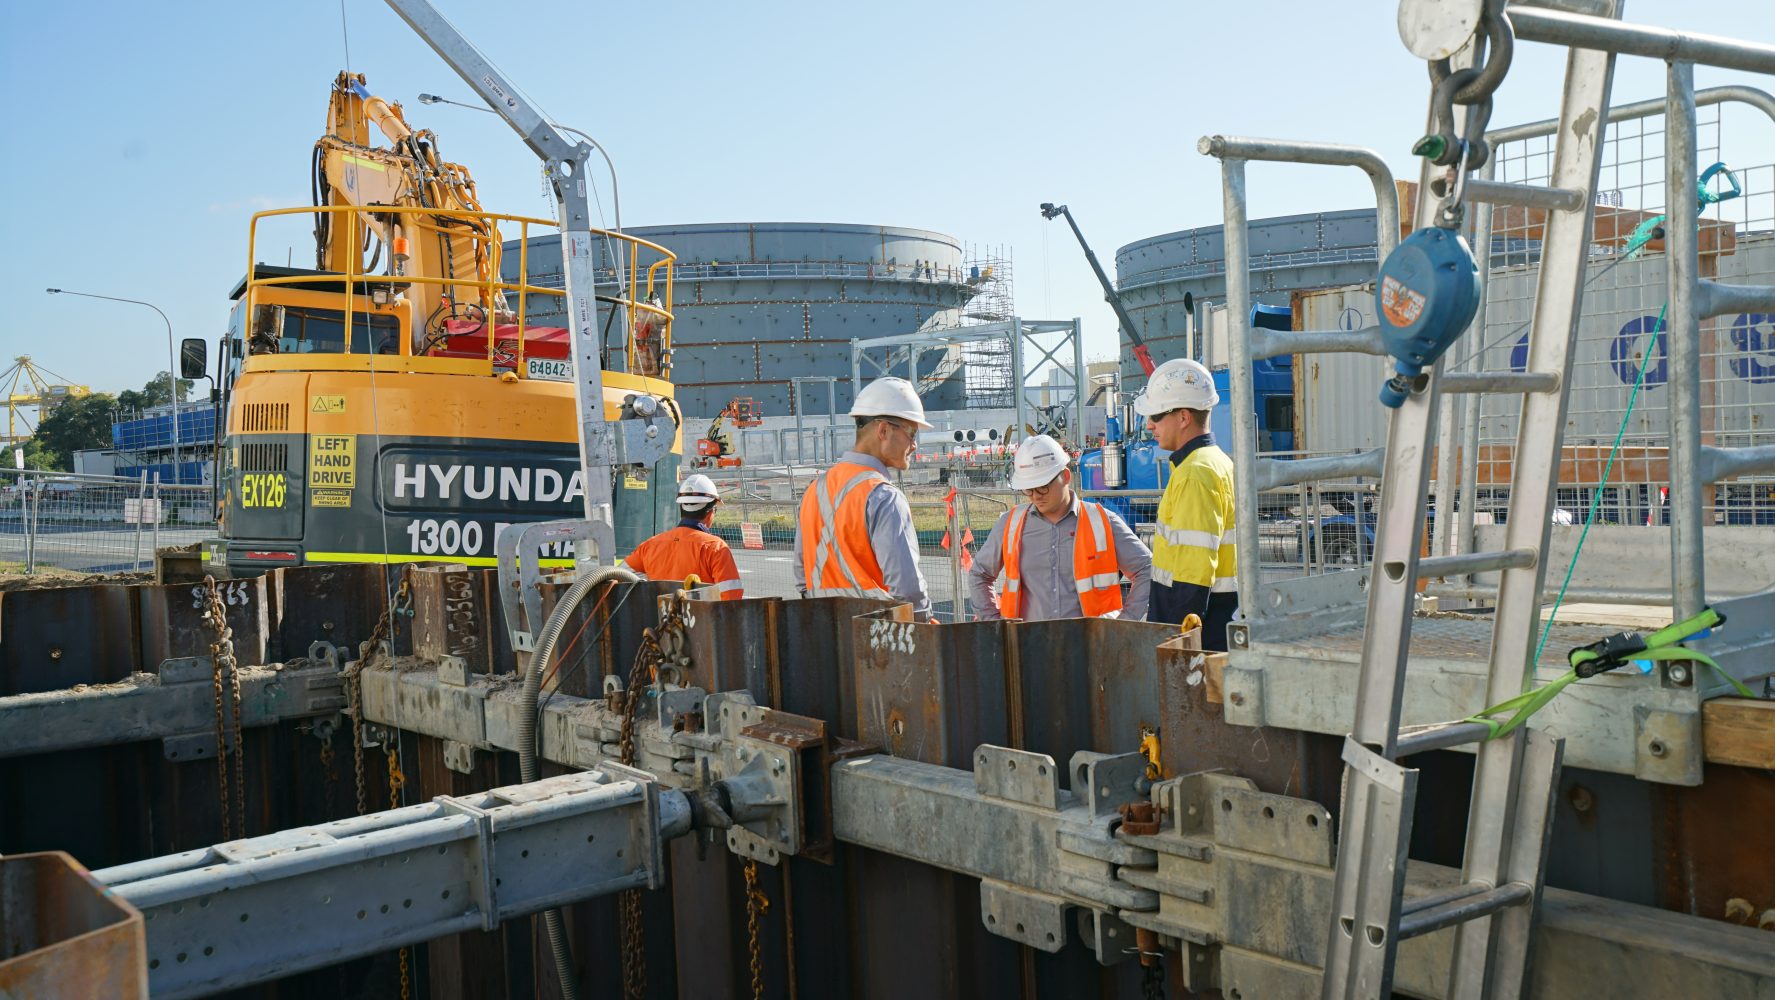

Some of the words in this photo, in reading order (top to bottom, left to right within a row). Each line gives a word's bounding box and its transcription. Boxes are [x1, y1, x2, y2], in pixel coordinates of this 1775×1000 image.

[530, 361, 566, 376] 84842
[317, 438, 349, 450] LEFT
[314, 455, 351, 467] HAND
[312, 471, 352, 484] DRIVE
[394, 463, 584, 503] HYUNDA
[242, 474, 284, 508] EX126
[407, 519, 483, 556] 1300
